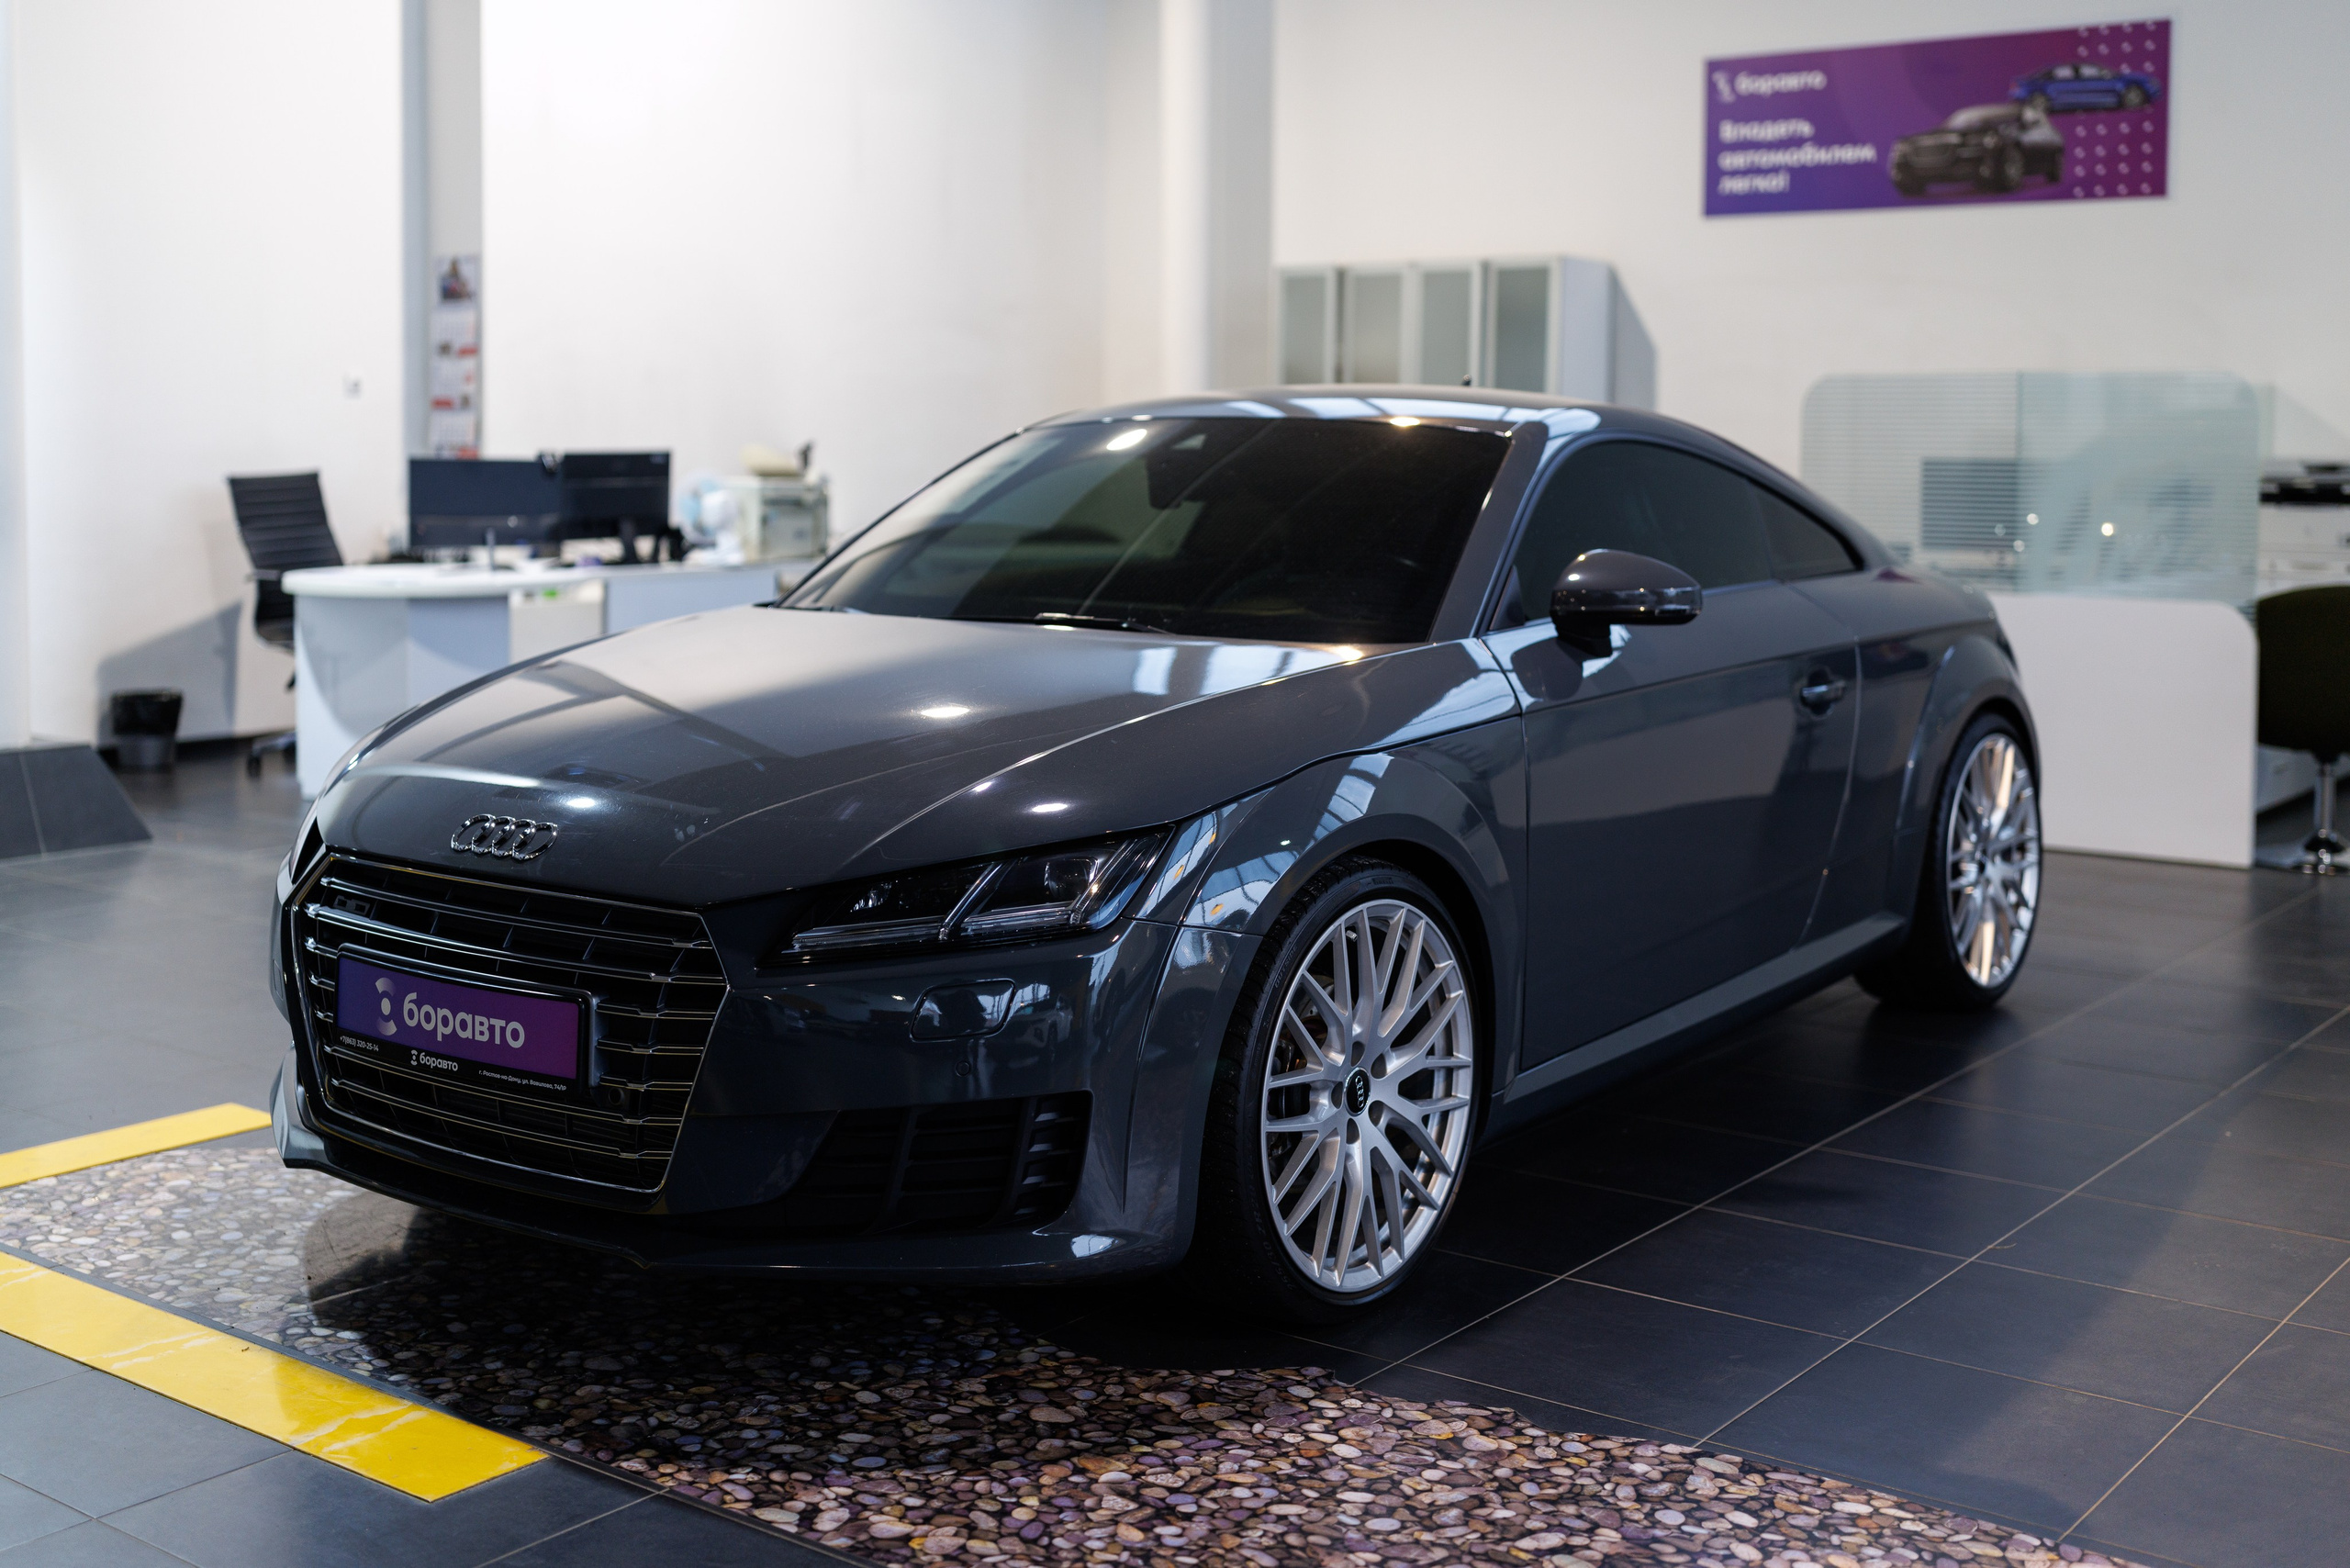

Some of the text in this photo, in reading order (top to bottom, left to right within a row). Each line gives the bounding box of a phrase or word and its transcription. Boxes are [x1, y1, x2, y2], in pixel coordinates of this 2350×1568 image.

[1735, 71, 1827, 97] боравто
[1719, 119, 1814, 143] Владеть
[1718, 142, 1876, 171] автомобилем
[1718, 169, 1789, 196] легко!
[1274, 943, 1297, 989] OUTSIDE
[403, 992, 525, 1048] боравто
[420, 1052, 459, 1071] боравто
